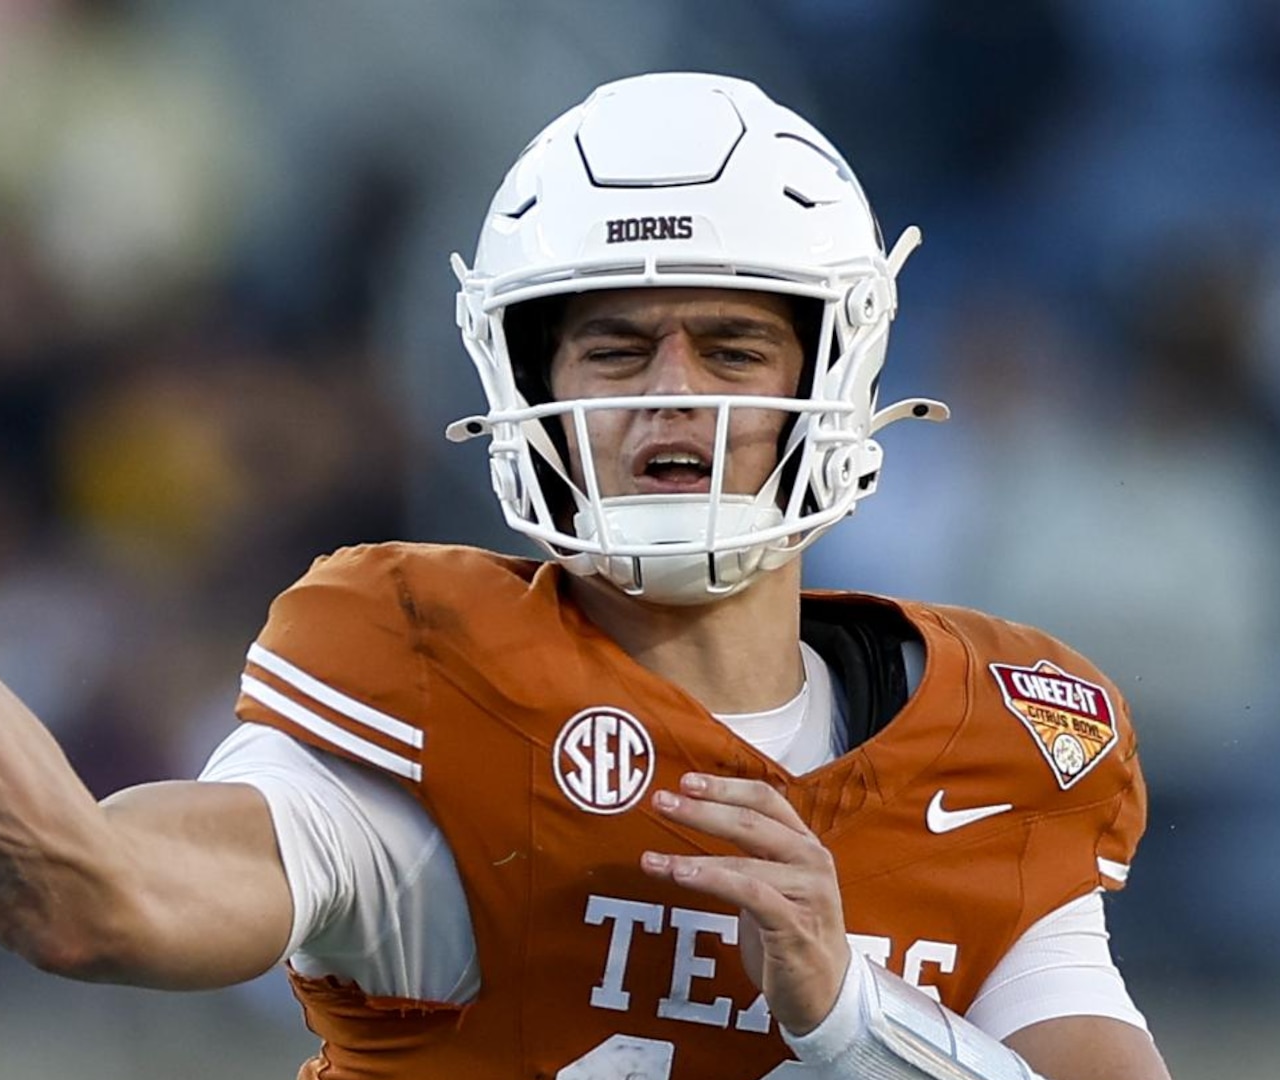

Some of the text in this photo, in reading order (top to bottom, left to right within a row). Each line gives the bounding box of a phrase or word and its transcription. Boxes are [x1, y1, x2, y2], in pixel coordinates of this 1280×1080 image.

[606, 216, 692, 243] HORNS
[1028, 706, 1103, 739] CITRUS BOWL
[563, 715, 645, 806] SEC
